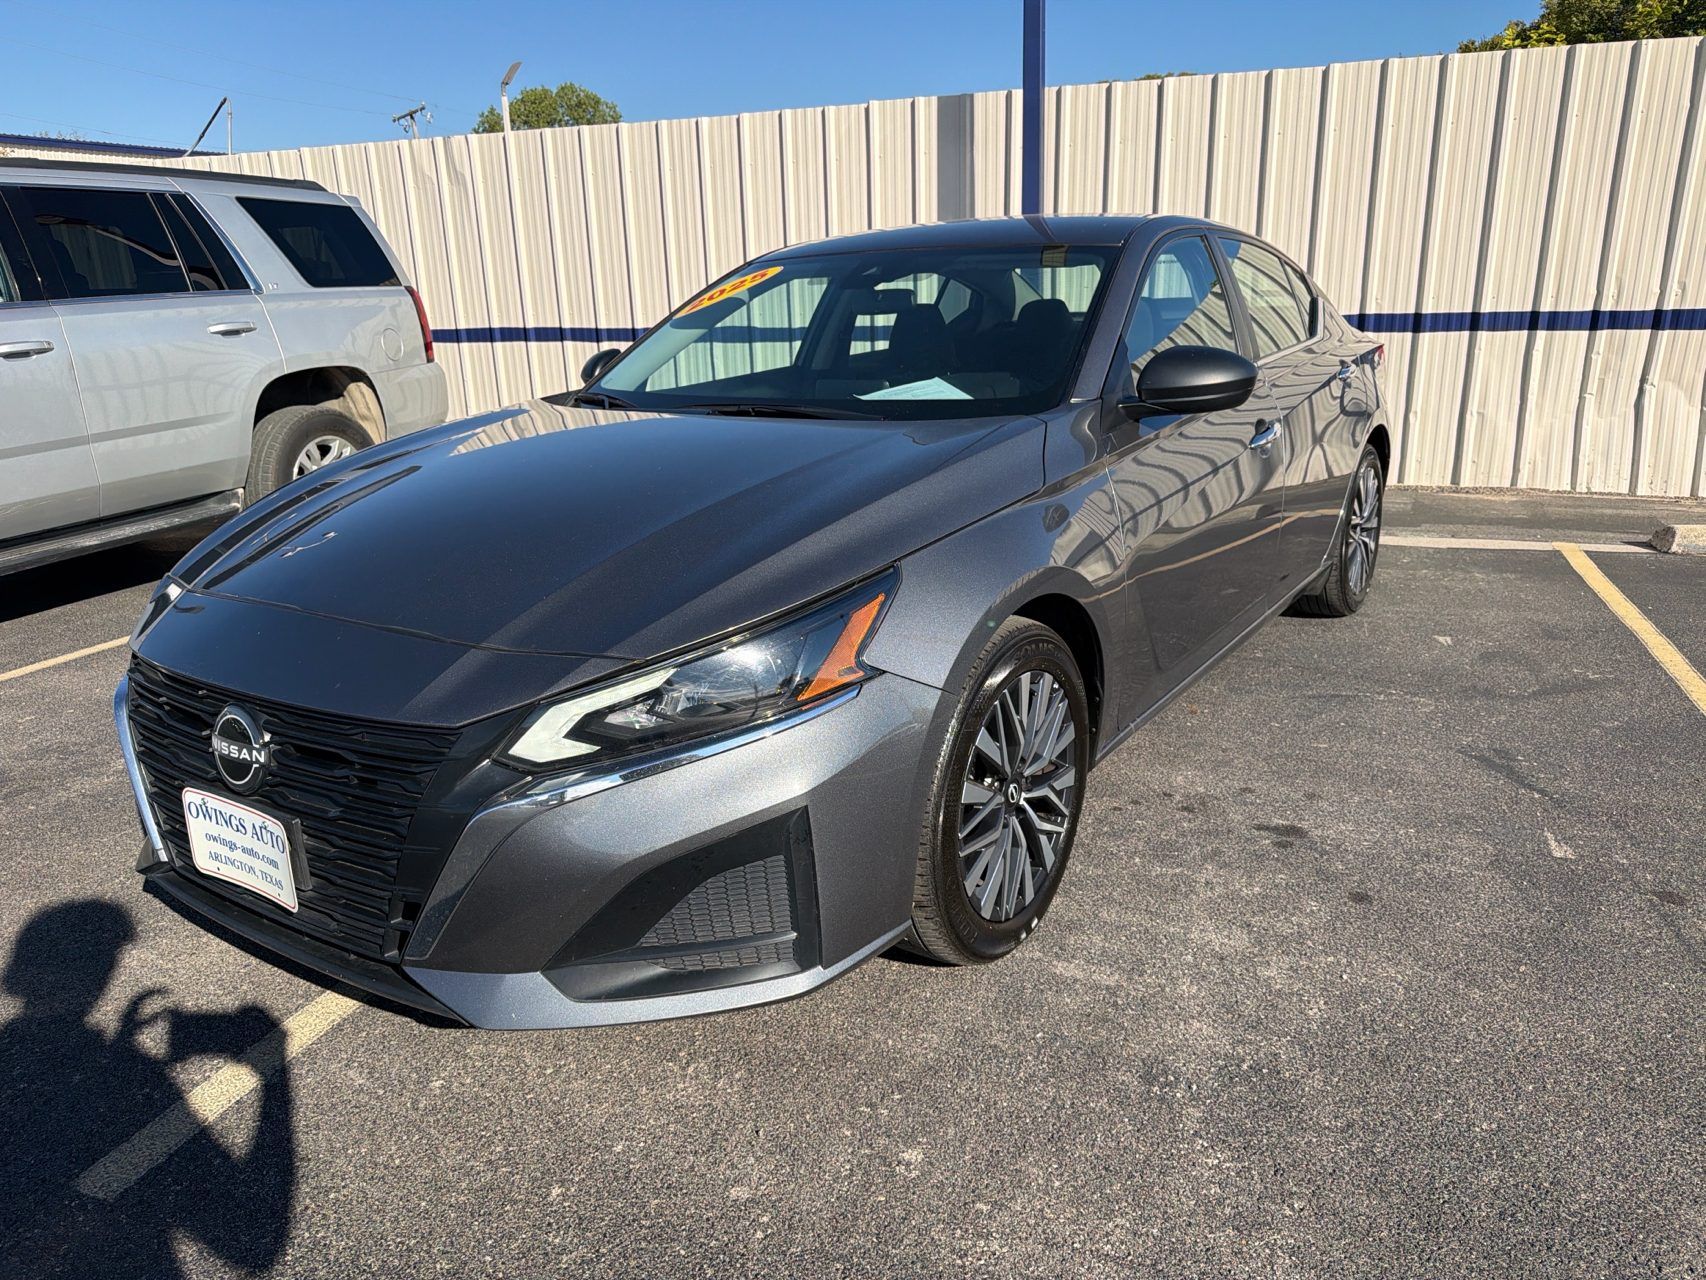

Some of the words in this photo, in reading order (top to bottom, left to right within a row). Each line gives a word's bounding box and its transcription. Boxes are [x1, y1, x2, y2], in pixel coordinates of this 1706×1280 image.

[685, 269, 770, 313] 2025
[211, 734, 265, 763] NISSAN
[187, 800, 248, 836] OWINGS
[250, 821, 285, 854] AUTO
[204, 831, 280, 870] owings-auto.com
[207, 849, 259, 880] ARLINGTON,
[258, 868, 284, 892] TEXAS
